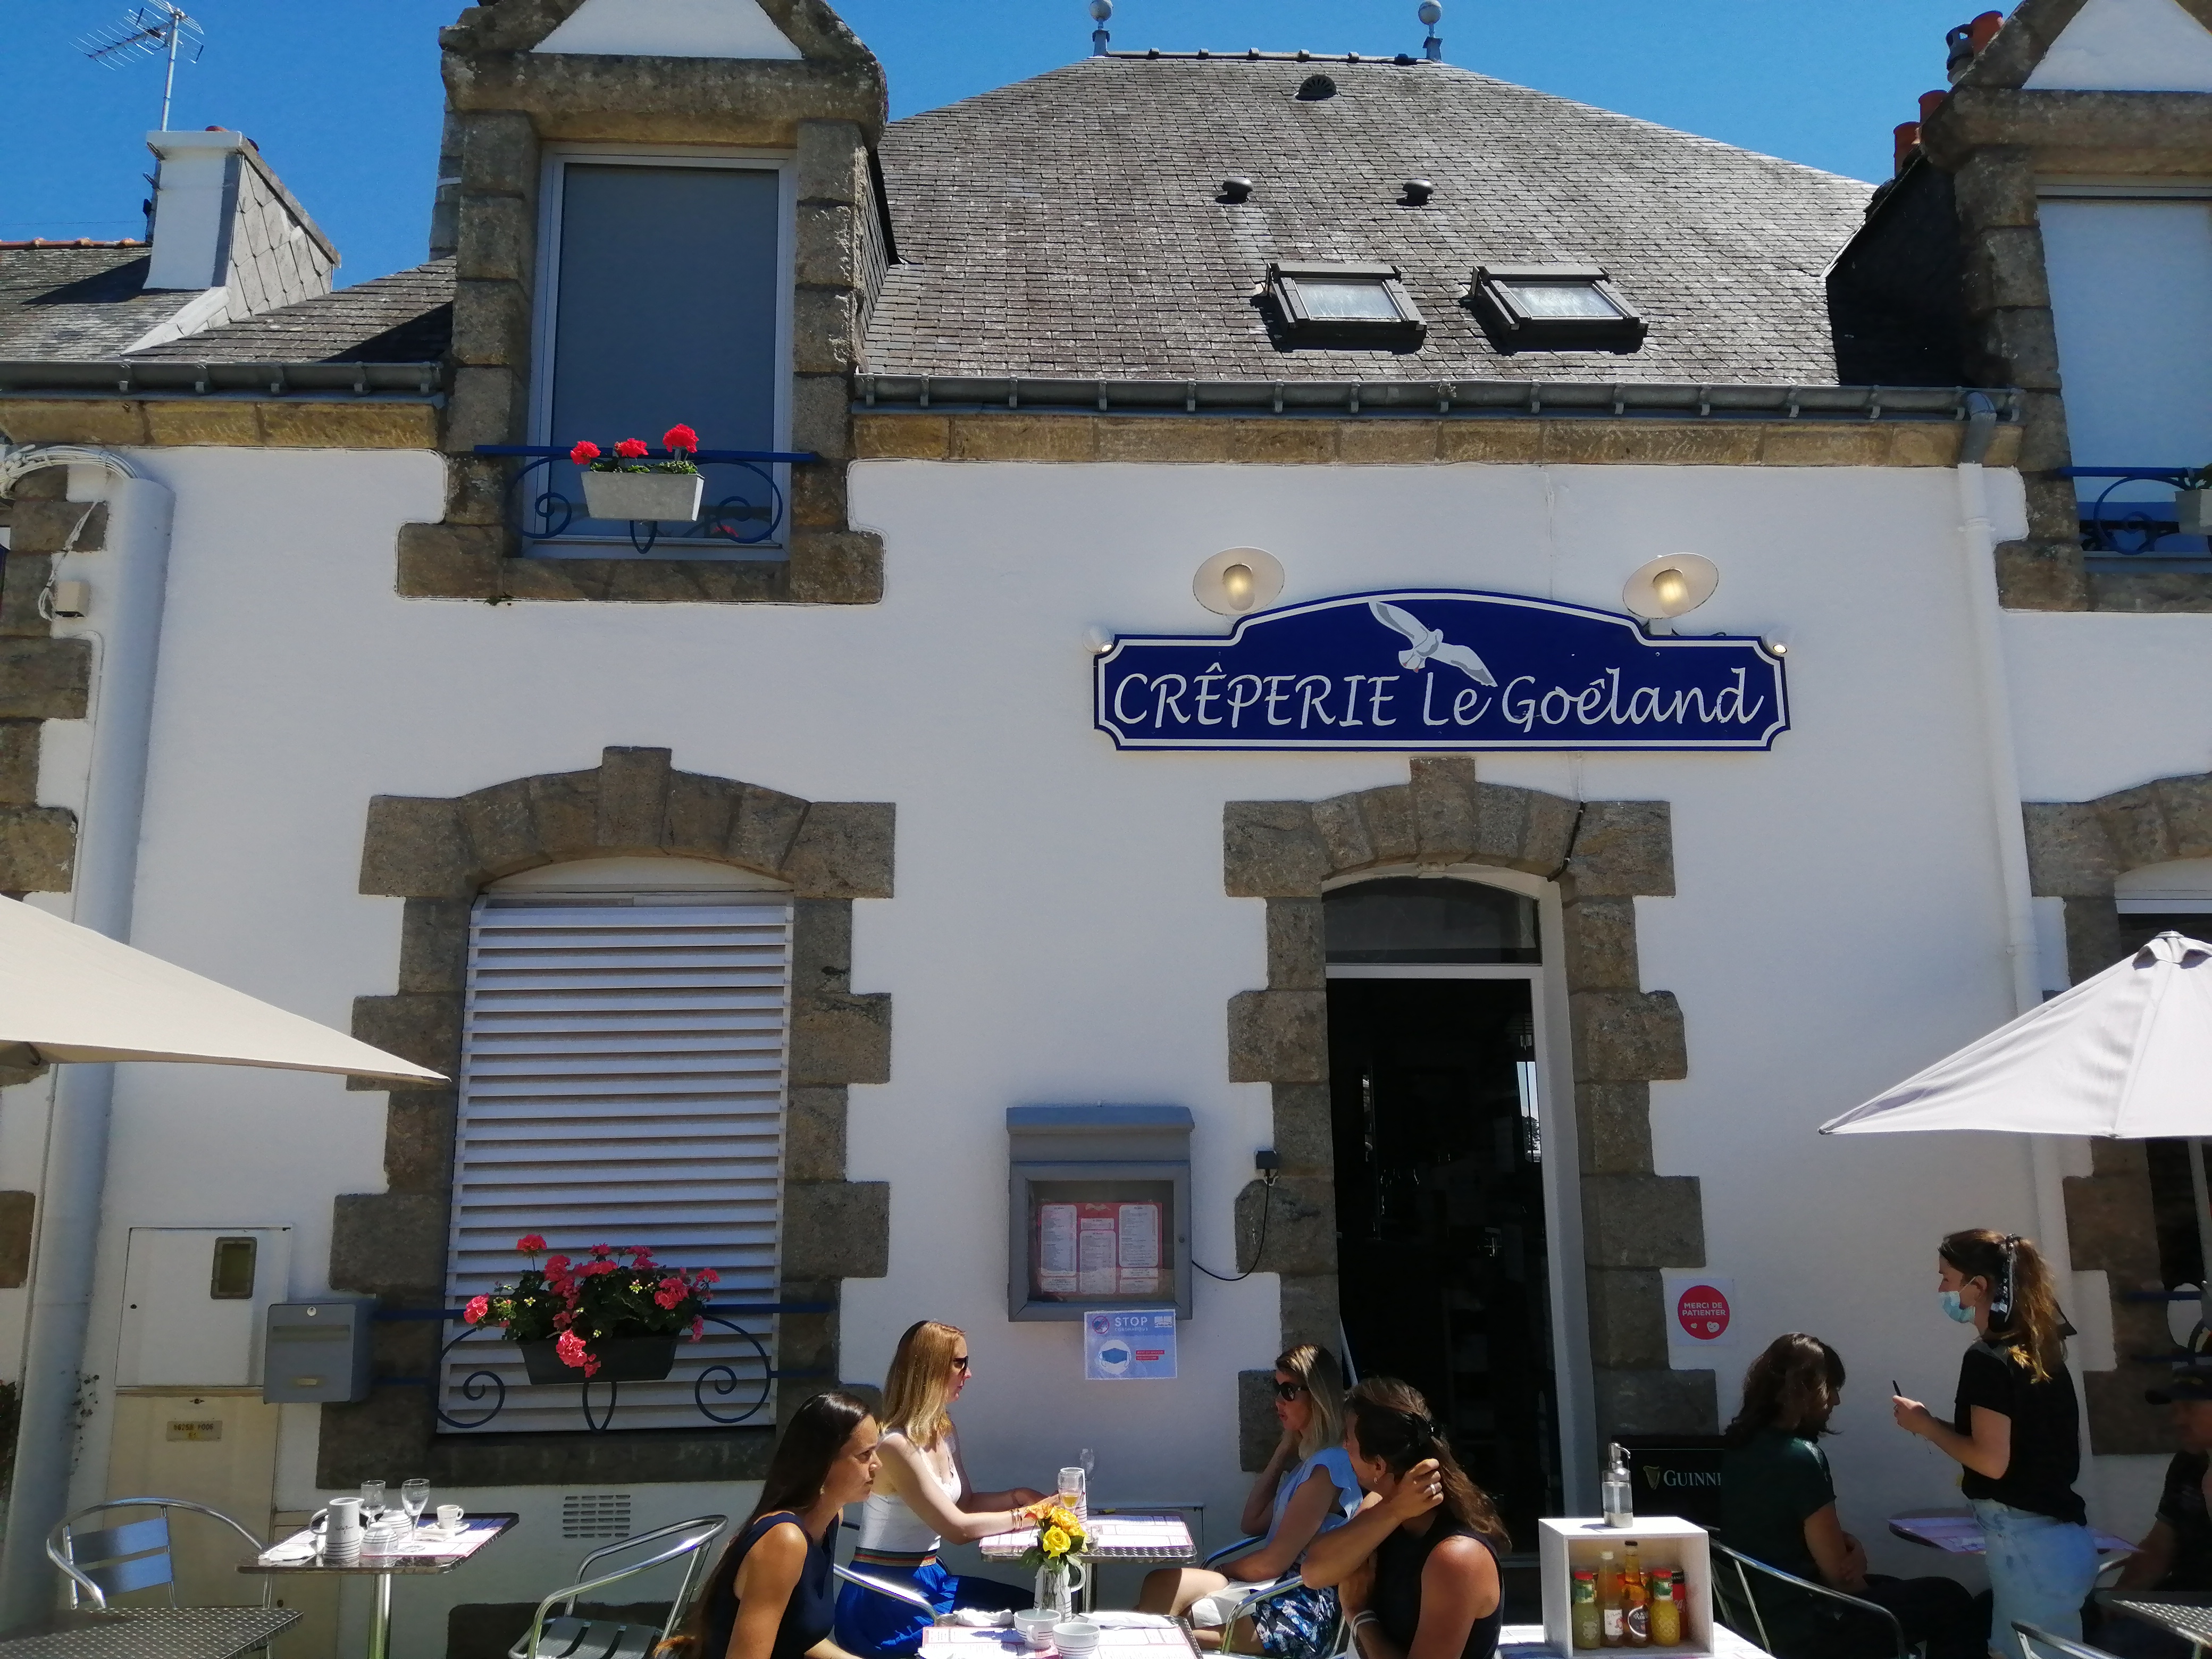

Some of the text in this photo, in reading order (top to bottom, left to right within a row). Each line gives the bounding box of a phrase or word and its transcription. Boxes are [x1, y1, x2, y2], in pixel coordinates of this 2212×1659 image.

[1115, 662, 1400, 729] CRÊPERIE
[1423, 672, 1492, 726] Le
[1115, 1316, 1148, 1327] STOP
